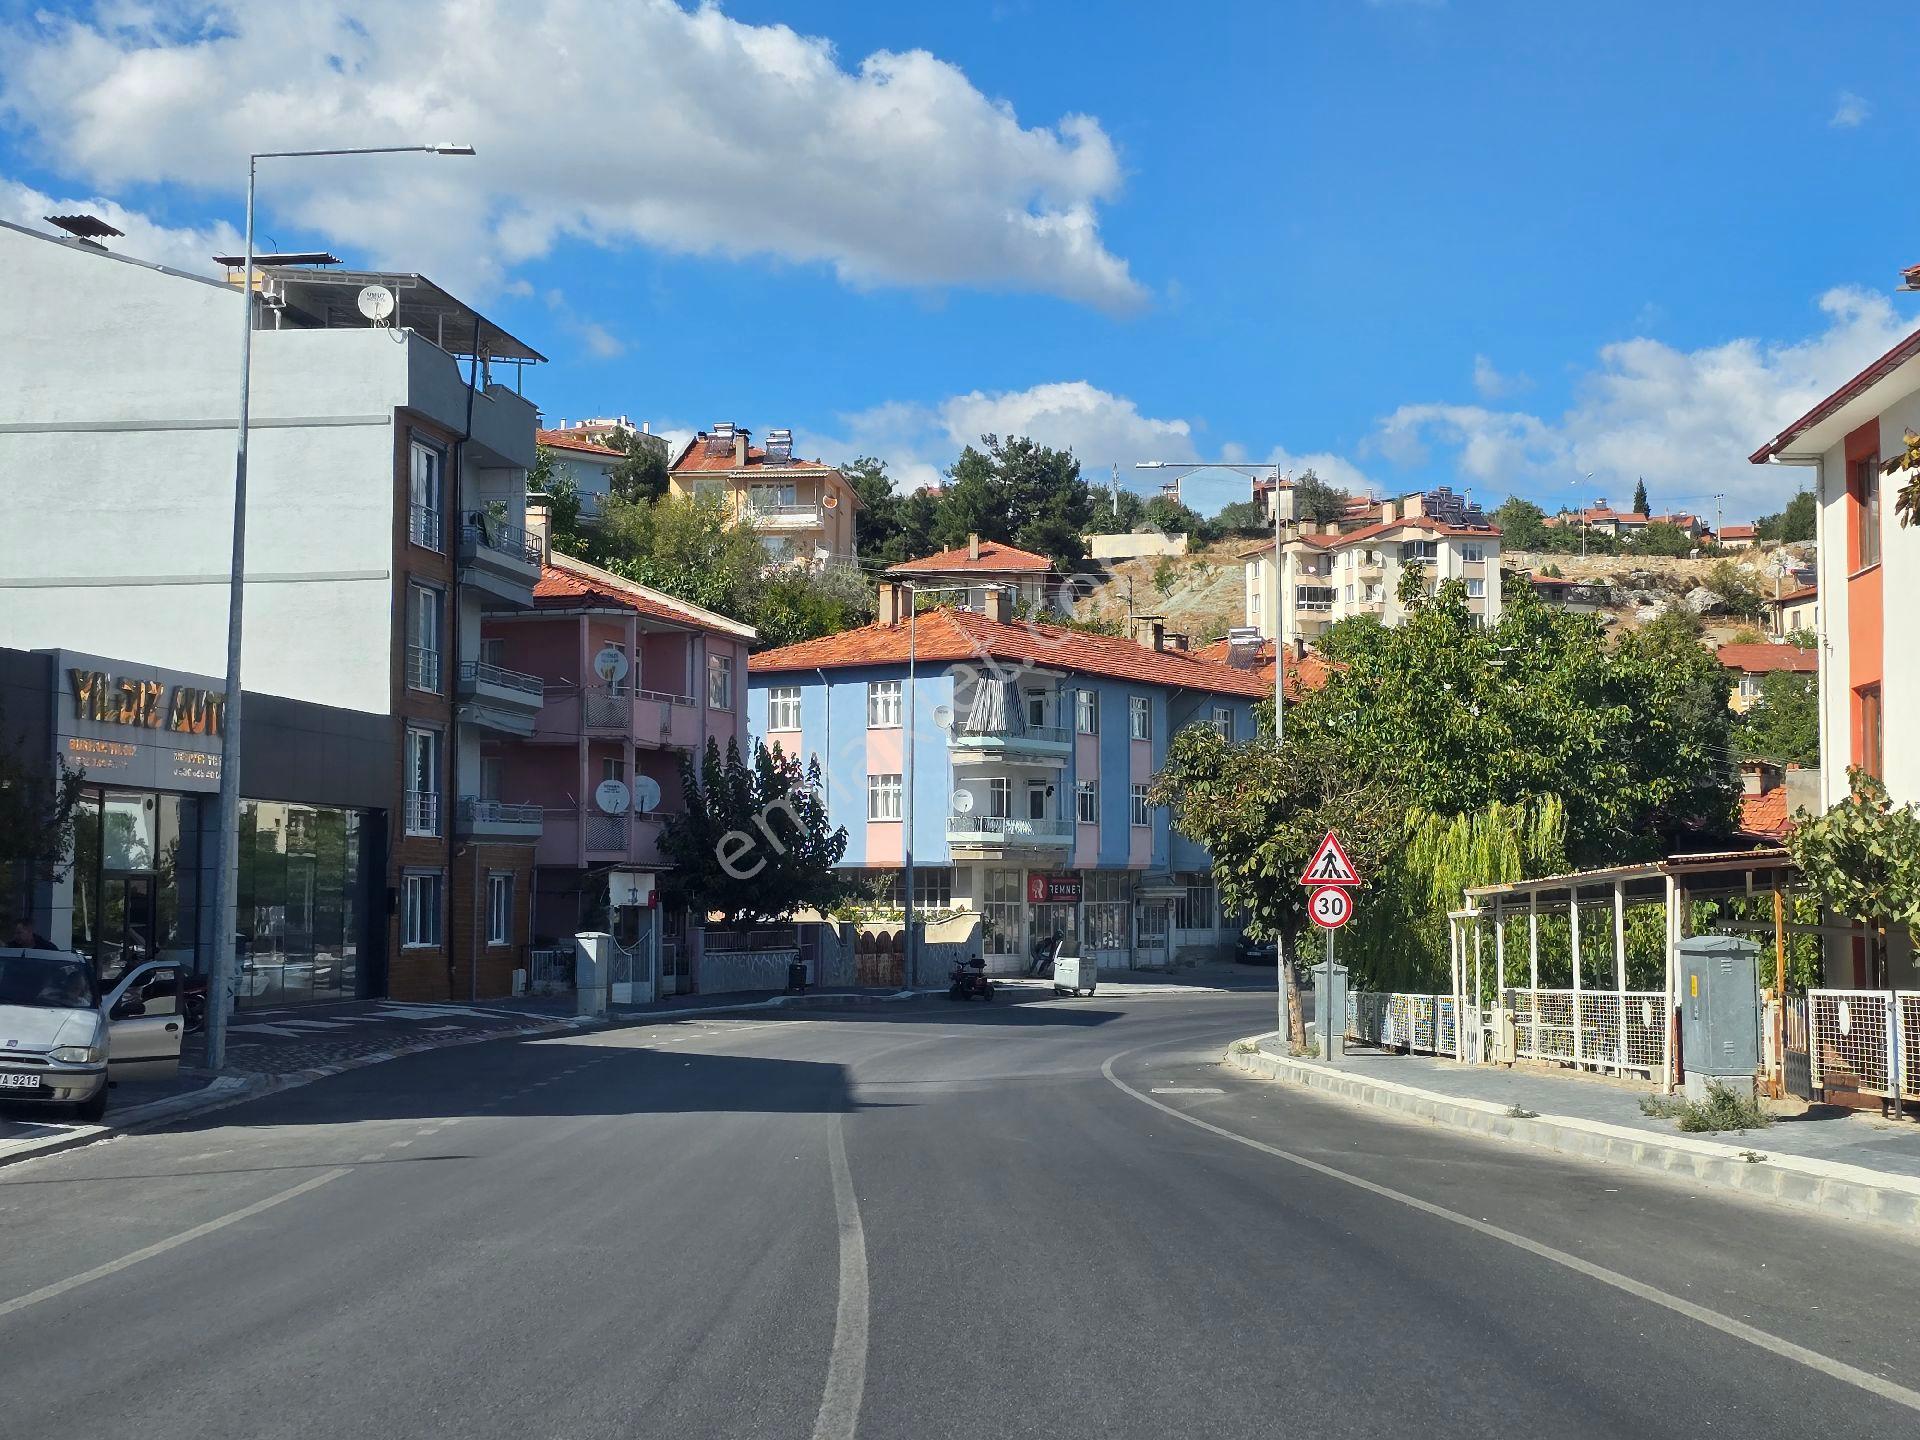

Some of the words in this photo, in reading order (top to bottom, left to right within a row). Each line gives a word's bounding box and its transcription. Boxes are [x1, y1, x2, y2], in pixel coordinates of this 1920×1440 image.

[67, 668, 165, 728] YILDIZ
[168, 685, 225, 737] AUT
[1319, 897, 1343, 915] 30
[12, 1075, 38, 1086] 9215
